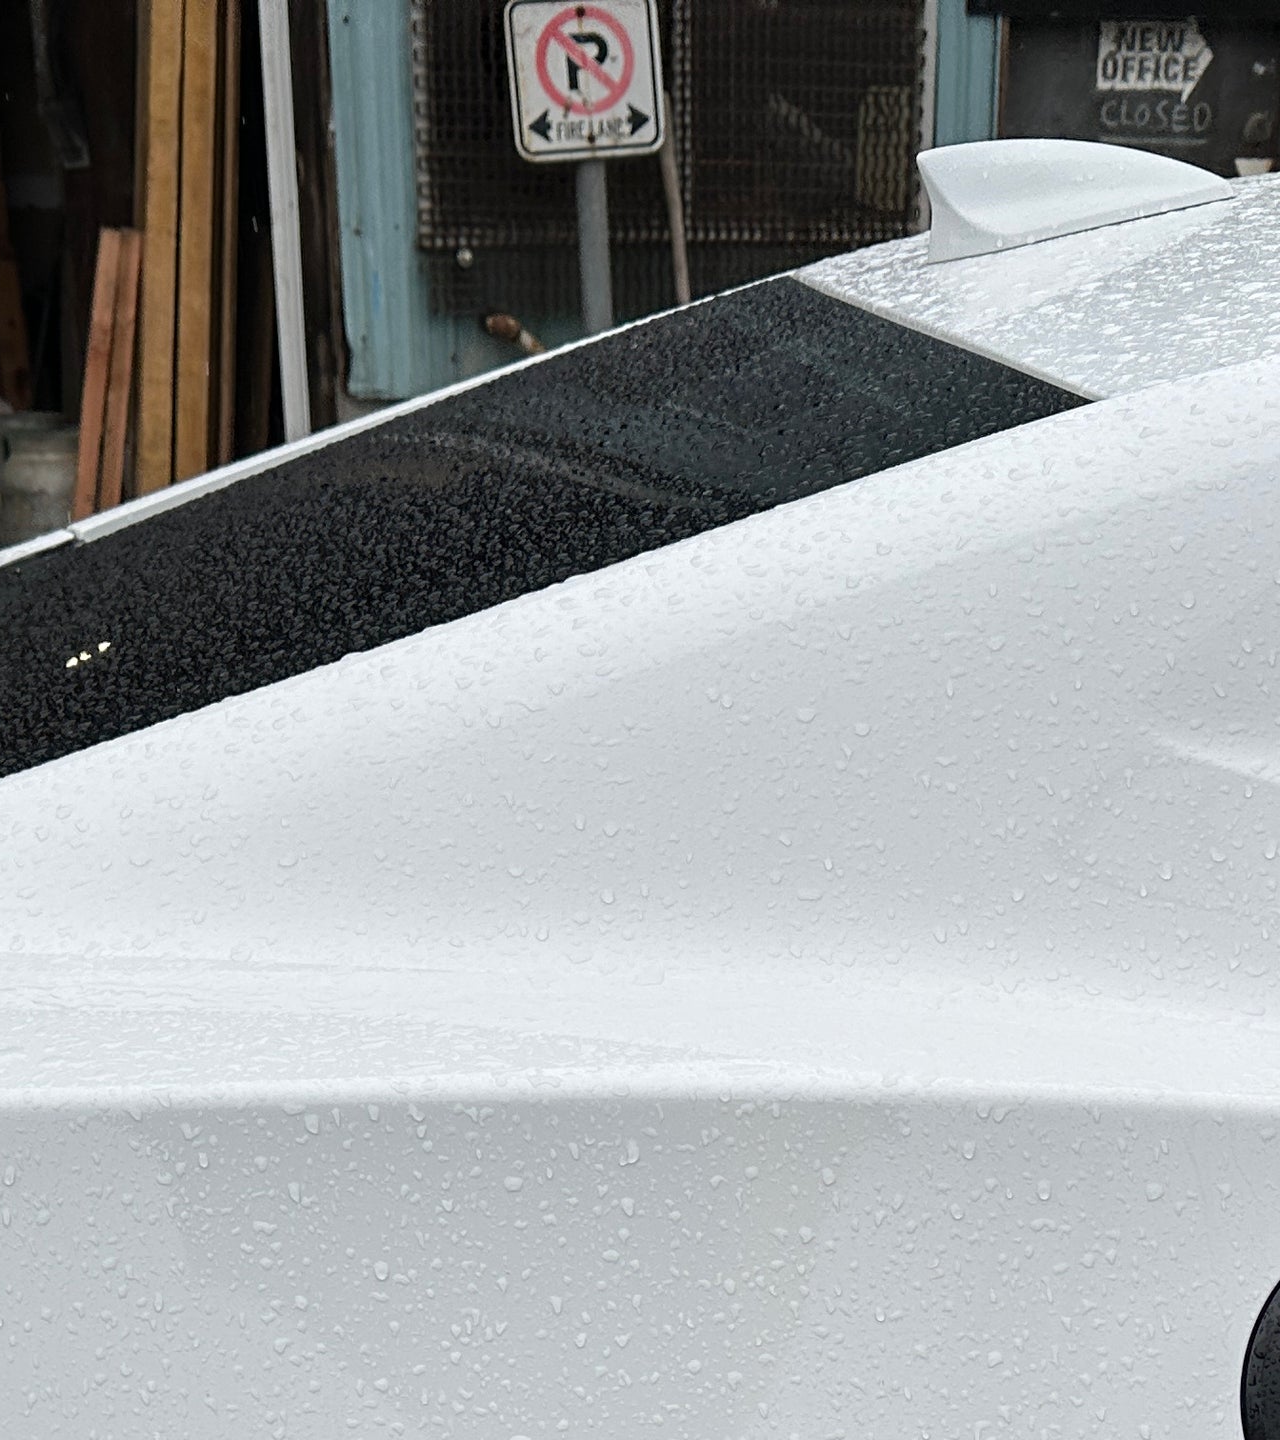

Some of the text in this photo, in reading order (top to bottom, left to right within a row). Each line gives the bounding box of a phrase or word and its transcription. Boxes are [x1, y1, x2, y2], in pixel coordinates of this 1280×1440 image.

[1115, 22, 1184, 52] NEW
[1101, 52, 1200, 84] OFFICE
[1101, 99, 1212, 133] CLOSED
